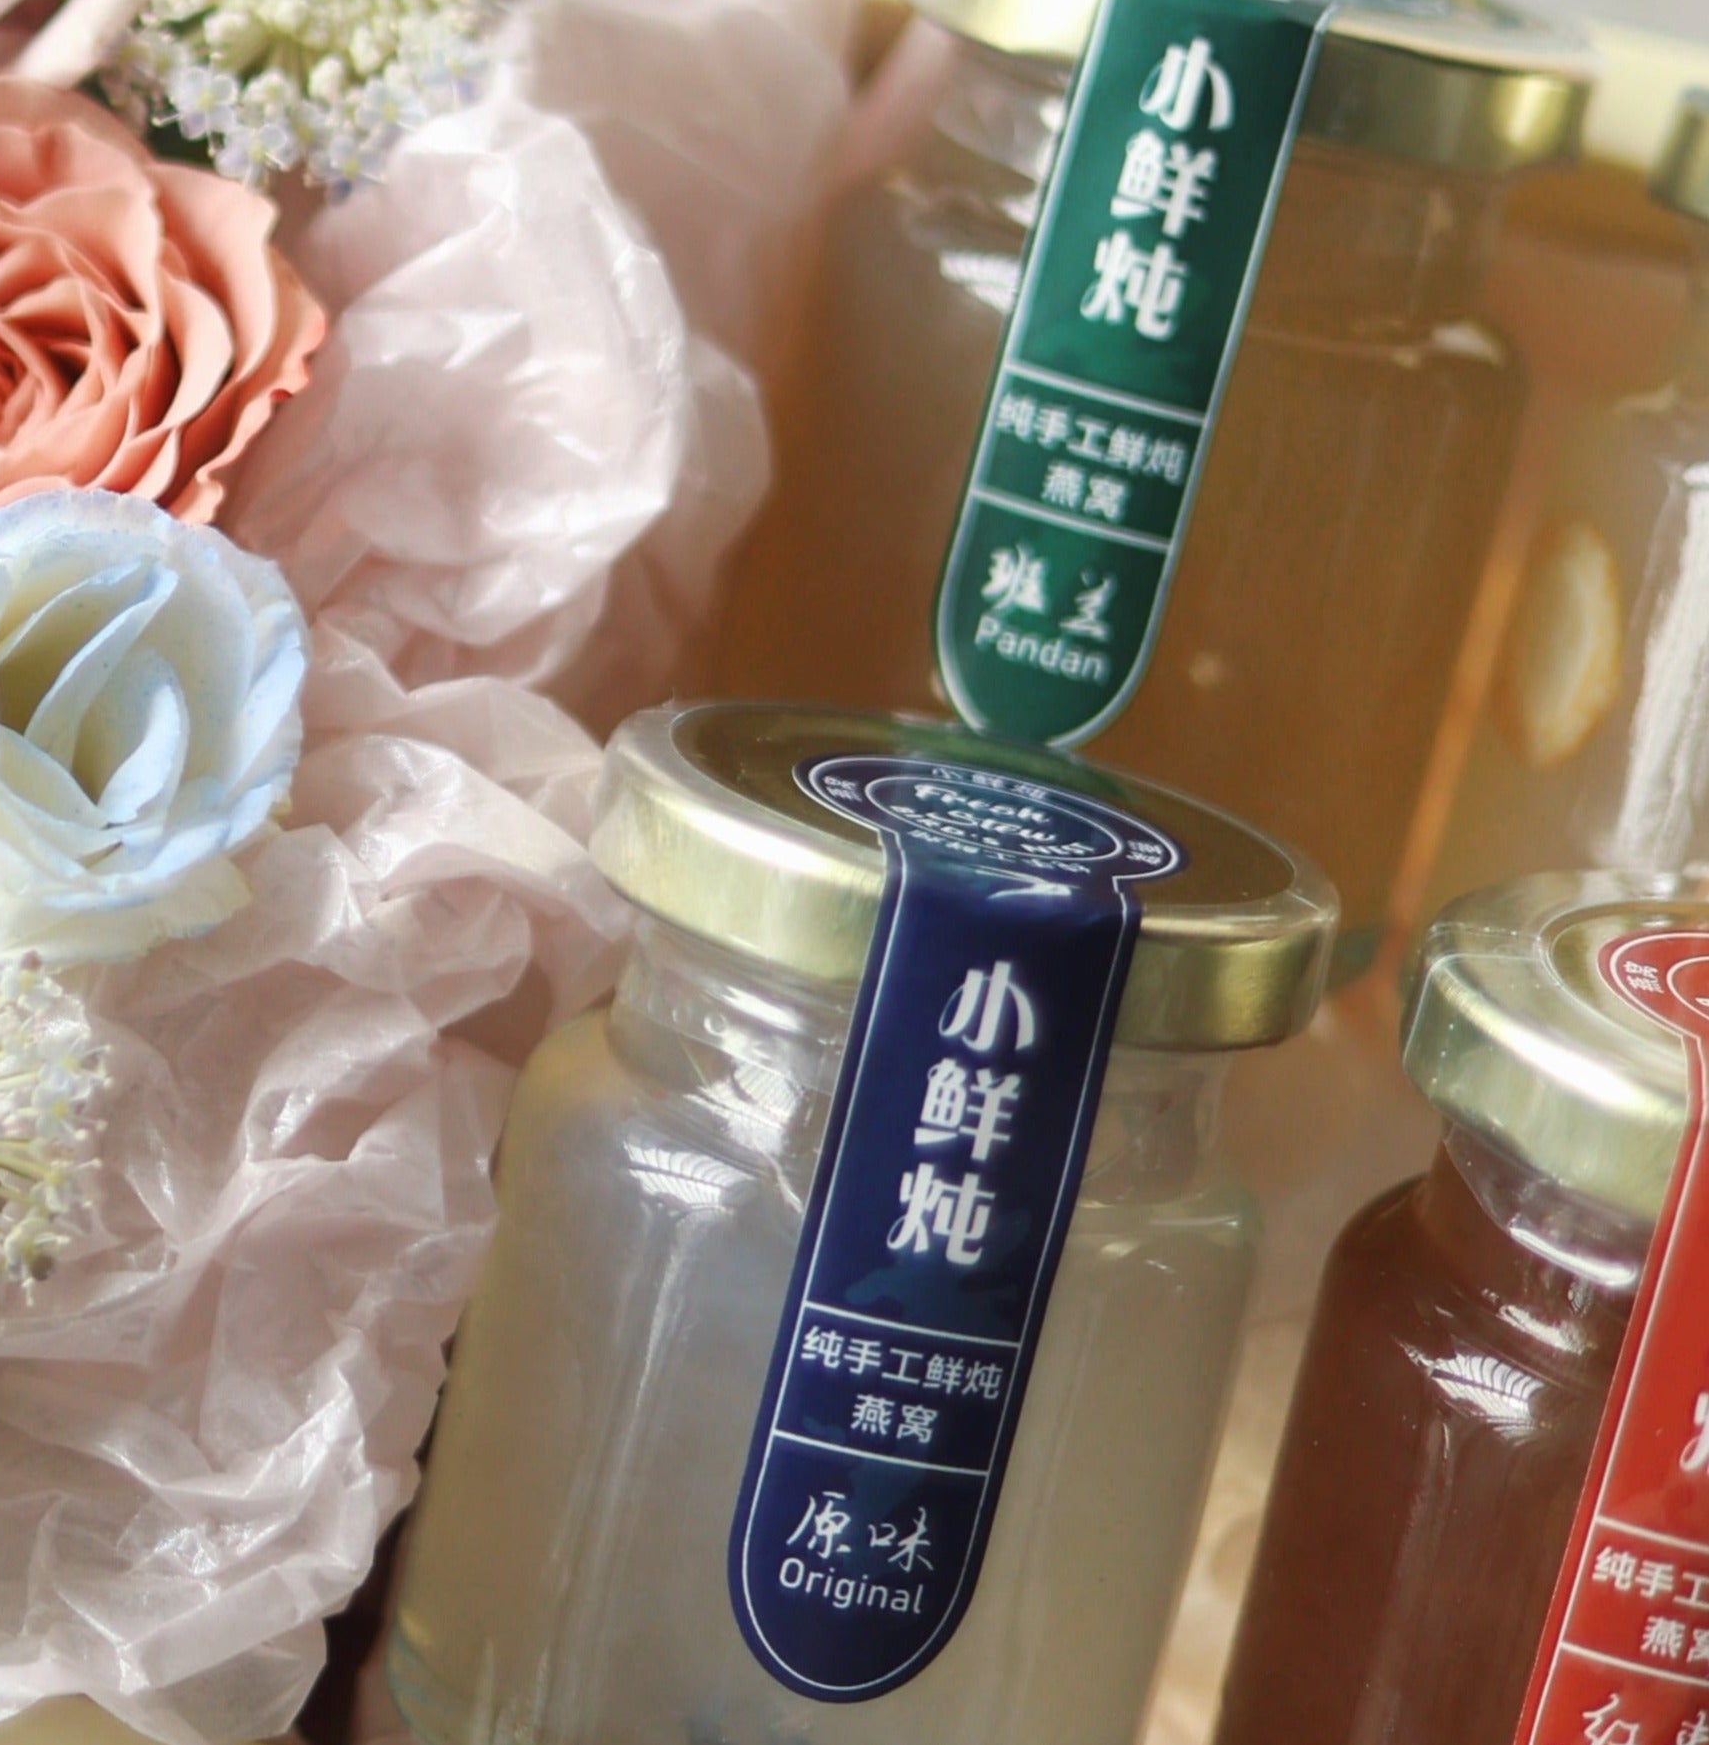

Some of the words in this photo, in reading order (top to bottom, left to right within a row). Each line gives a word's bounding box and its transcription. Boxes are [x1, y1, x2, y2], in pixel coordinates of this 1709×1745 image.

[1079, 36, 1235, 341] 小鲜炖
[974, 614, 1107, 685] Pandan
[914, 783, 1050, 823] Fresh
[887, 960, 1035, 1265] 小鲜炖
[800, 1326, 1003, 1400] 纯手工鲜炖
[850, 1393, 939, 1443] 燕窝
[786, 1491, 934, 1572] 原味
[779, 1557, 924, 1614] Original
